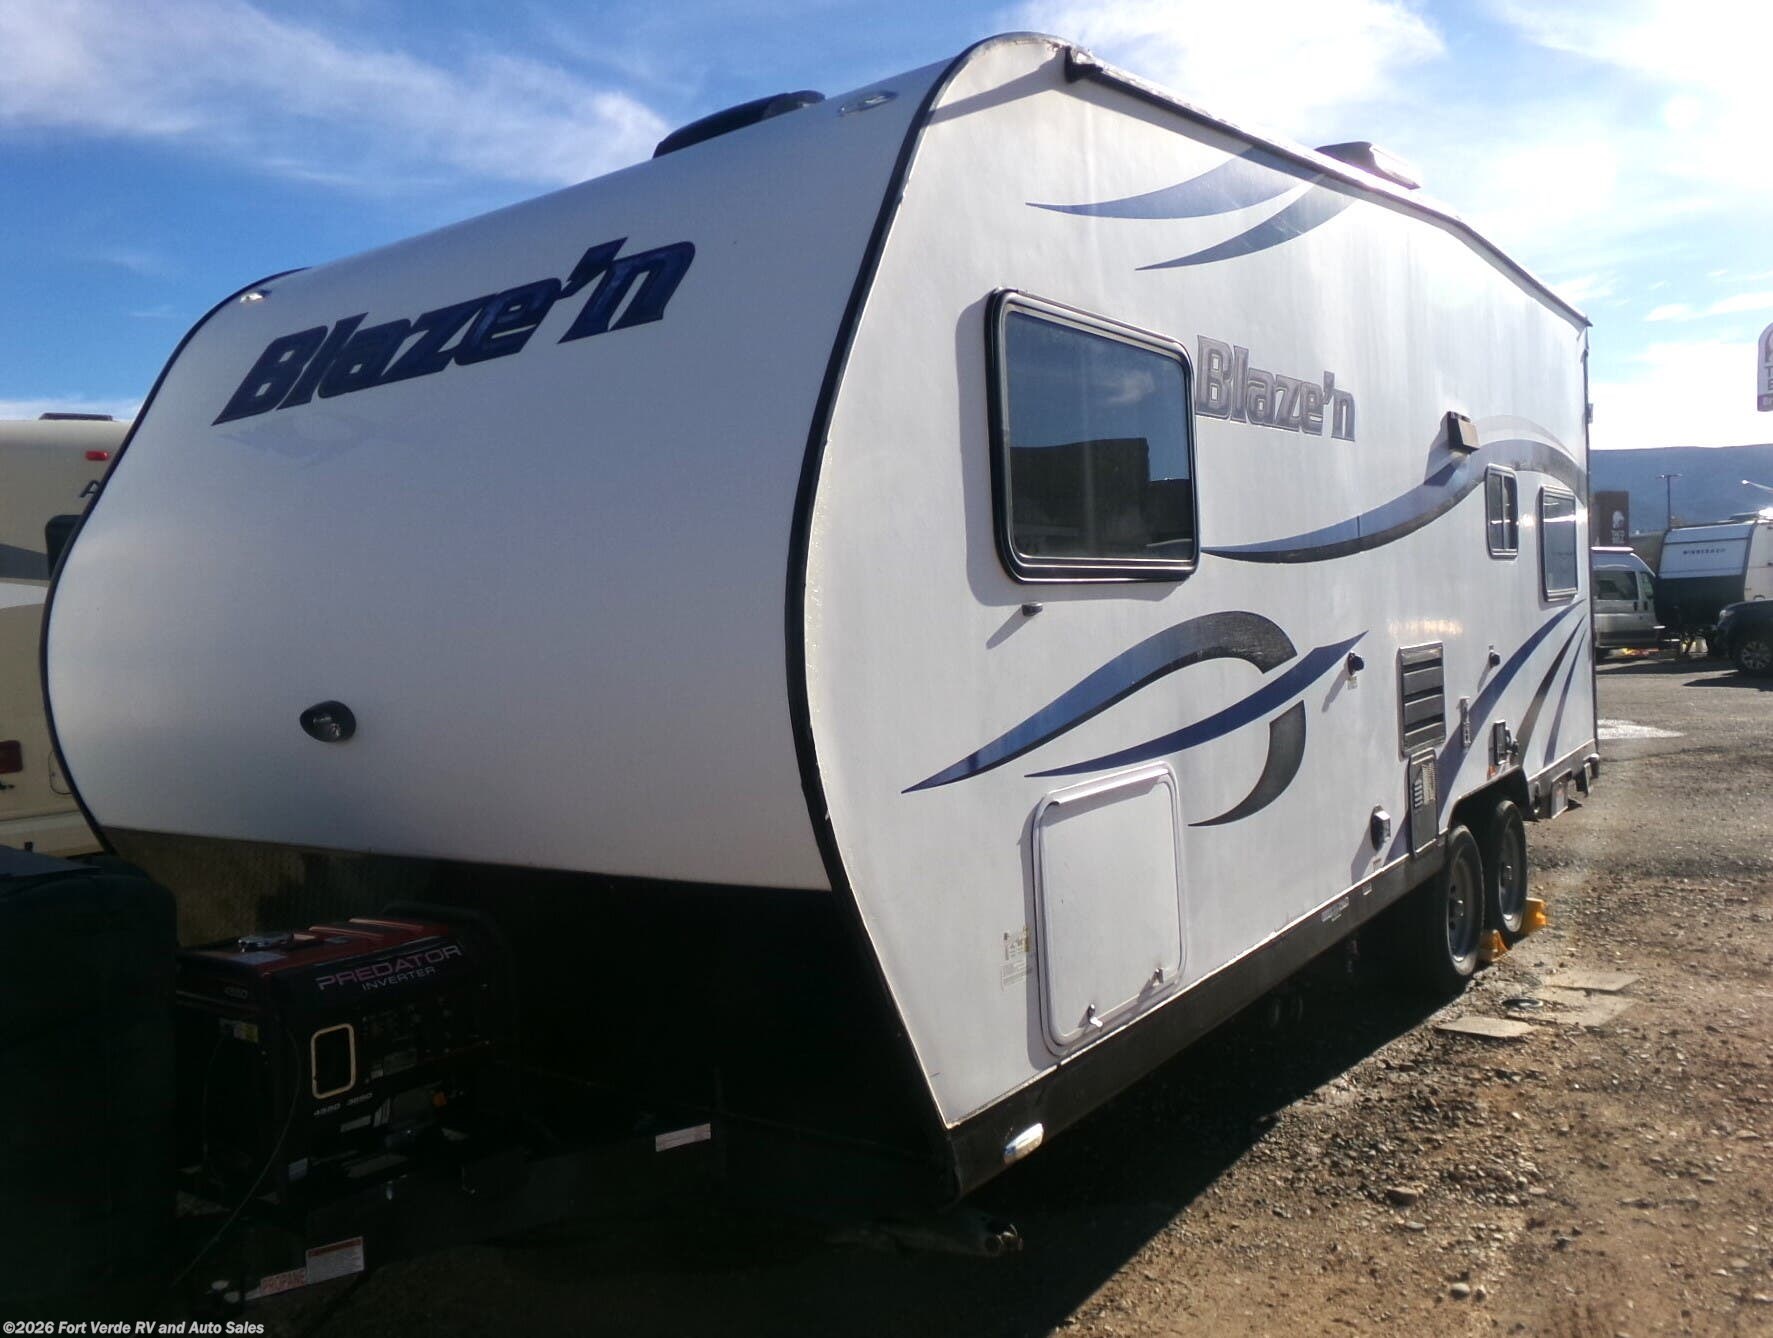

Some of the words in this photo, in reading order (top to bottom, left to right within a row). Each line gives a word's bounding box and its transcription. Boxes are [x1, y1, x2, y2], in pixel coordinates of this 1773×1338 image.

[211, 237, 696, 426] Blaze'n
[1195, 335, 1355, 441] Blaze'n
[315, 944, 464, 991] PREDATOR
[361, 966, 437, 991] INVERTER
